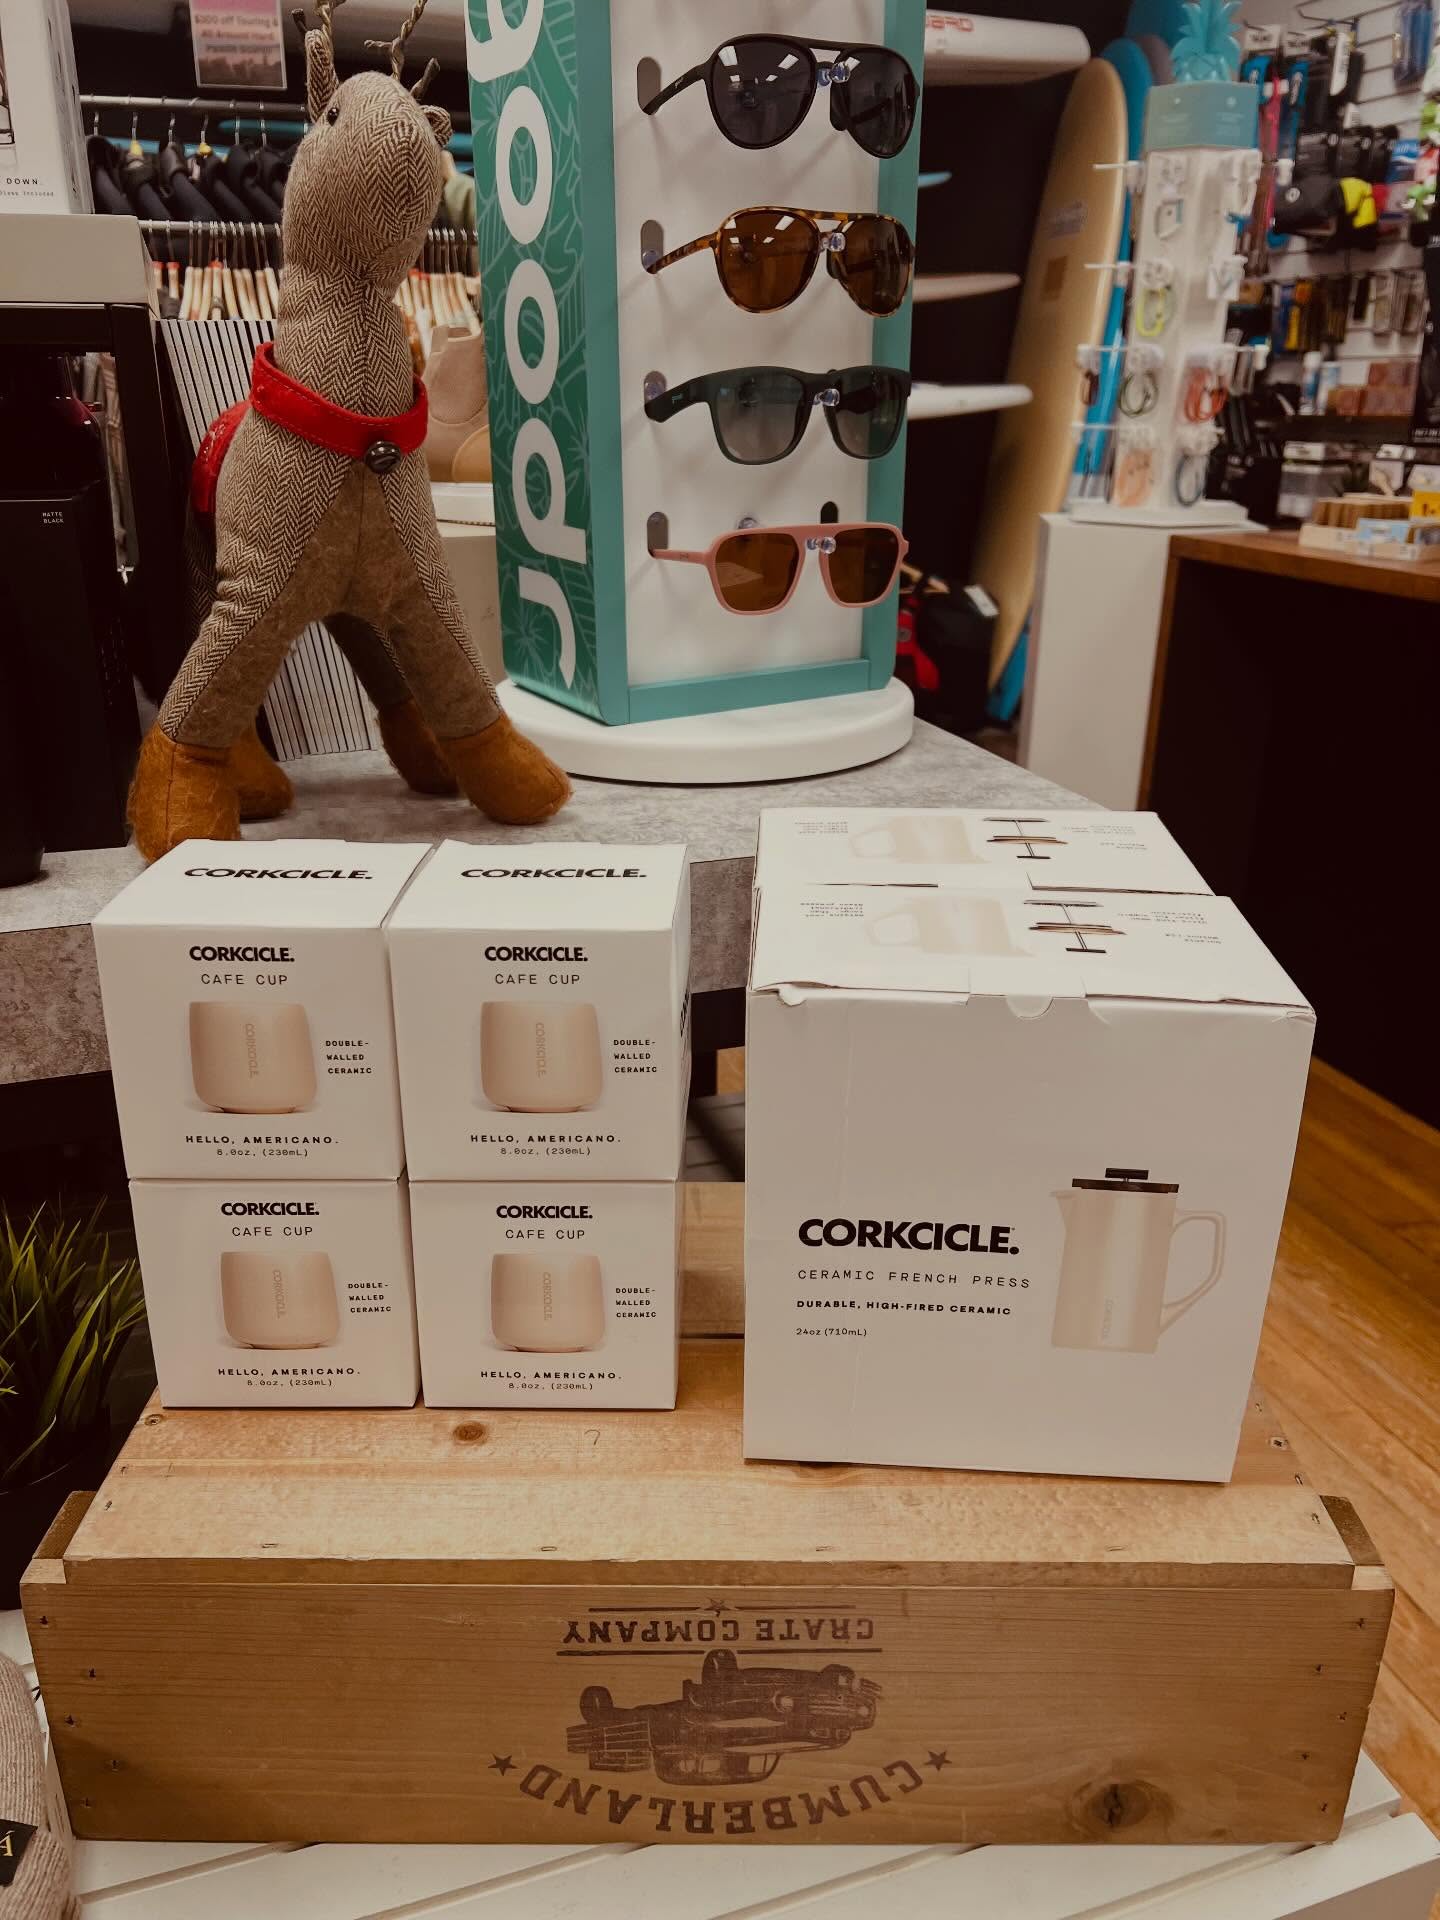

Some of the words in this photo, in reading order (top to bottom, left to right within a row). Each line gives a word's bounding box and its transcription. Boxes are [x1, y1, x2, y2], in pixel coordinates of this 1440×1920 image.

[6, 177, 38, 185] DOWN
[184, 868, 373, 880] CORKCICLE.
[461, 868, 647, 878] CORKCICLE.
[189, 946, 295, 962] CORKCICLE.
[484, 946, 588, 962] CORKCICLE.
[201, 974, 245, 985] CAFE
[256, 974, 288, 985] CUP
[495, 974, 537, 985] CAFE
[549, 974, 580, 985] CUP
[186, 1135, 235, 1145] HELLO,
[243, 1136, 339, 1144] AMERICANO.
[470, 1135, 519, 1143] HELLO,
[528, 1135, 621, 1143] AMERICANO.
[262, 1148, 308, 1157] (230mL)
[545, 1148, 591, 1156] (230mL)
[221, 1202, 320, 1216] CORKCICLE.
[496, 1205, 593, 1219] CORKCICLE.
[232, 1227, 273, 1237] CAFE
[283, 1226, 313, 1236] CUP
[505, 1229, 545, 1239] CAFE
[556, 1229, 585, 1240] CUP
[799, 1218, 1020, 1255] CORKCICLE.
[798, 1270, 874, 1281] CERAMIC
[888, 1271, 957, 1284] FRENCH
[972, 1275, 1030, 1289] PRESS
[796, 1300, 861, 1309] DURABLE,
[867, 1301, 944, 1312] HIGH-FIRED
[950, 1305, 1011, 1315] CERAMIC
[796, 1328, 821, 1336] 24oz
[824, 1328, 867, 1337] (710mL)
[218, 1369, 264, 1377] HELLO,
[271, 1368, 361, 1376] AMERICANO.
[480, 1371, 526, 1379] HELLO,
[289, 1379, 333, 1387] (230mL)
[562, 1619, 739, 1644] COMPANY
[755, 1619, 874, 1642] CRATE
[519, 1760, 924, 1835] CUMBERLAND
